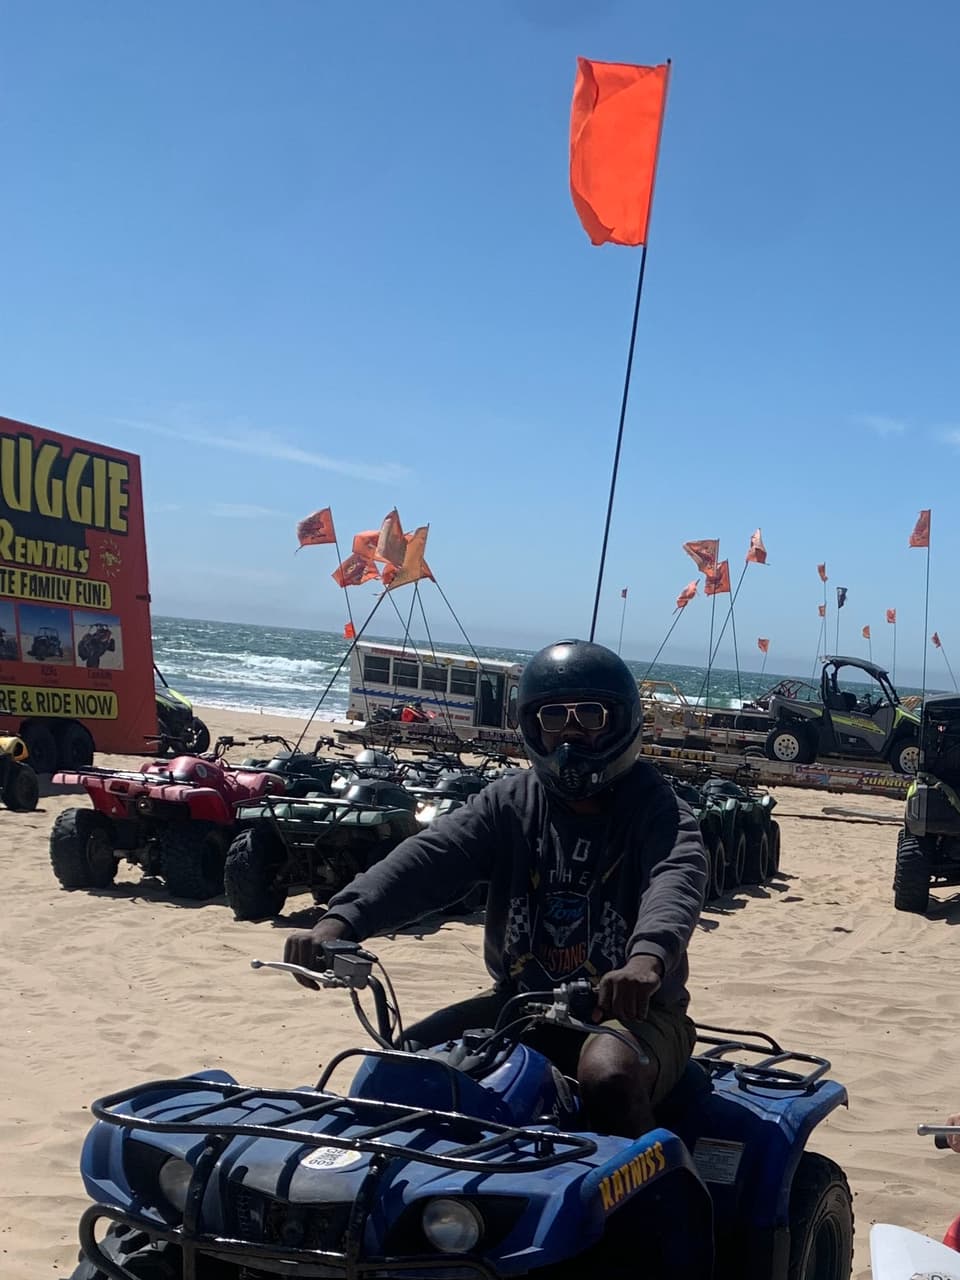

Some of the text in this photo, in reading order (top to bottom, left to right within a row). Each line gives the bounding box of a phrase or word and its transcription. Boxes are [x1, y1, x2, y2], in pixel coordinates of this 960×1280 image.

[0, 435, 130, 533] UGGIE
[20, 570, 71, 601] FAMILY
[76, 580, 107, 606] FUN!
[21, 691, 33, 712] &
[36, 692, 72, 714] RIDE
[75, 695, 113, 716] NOW
[598, 1141, 666, 1211] KATNISS
